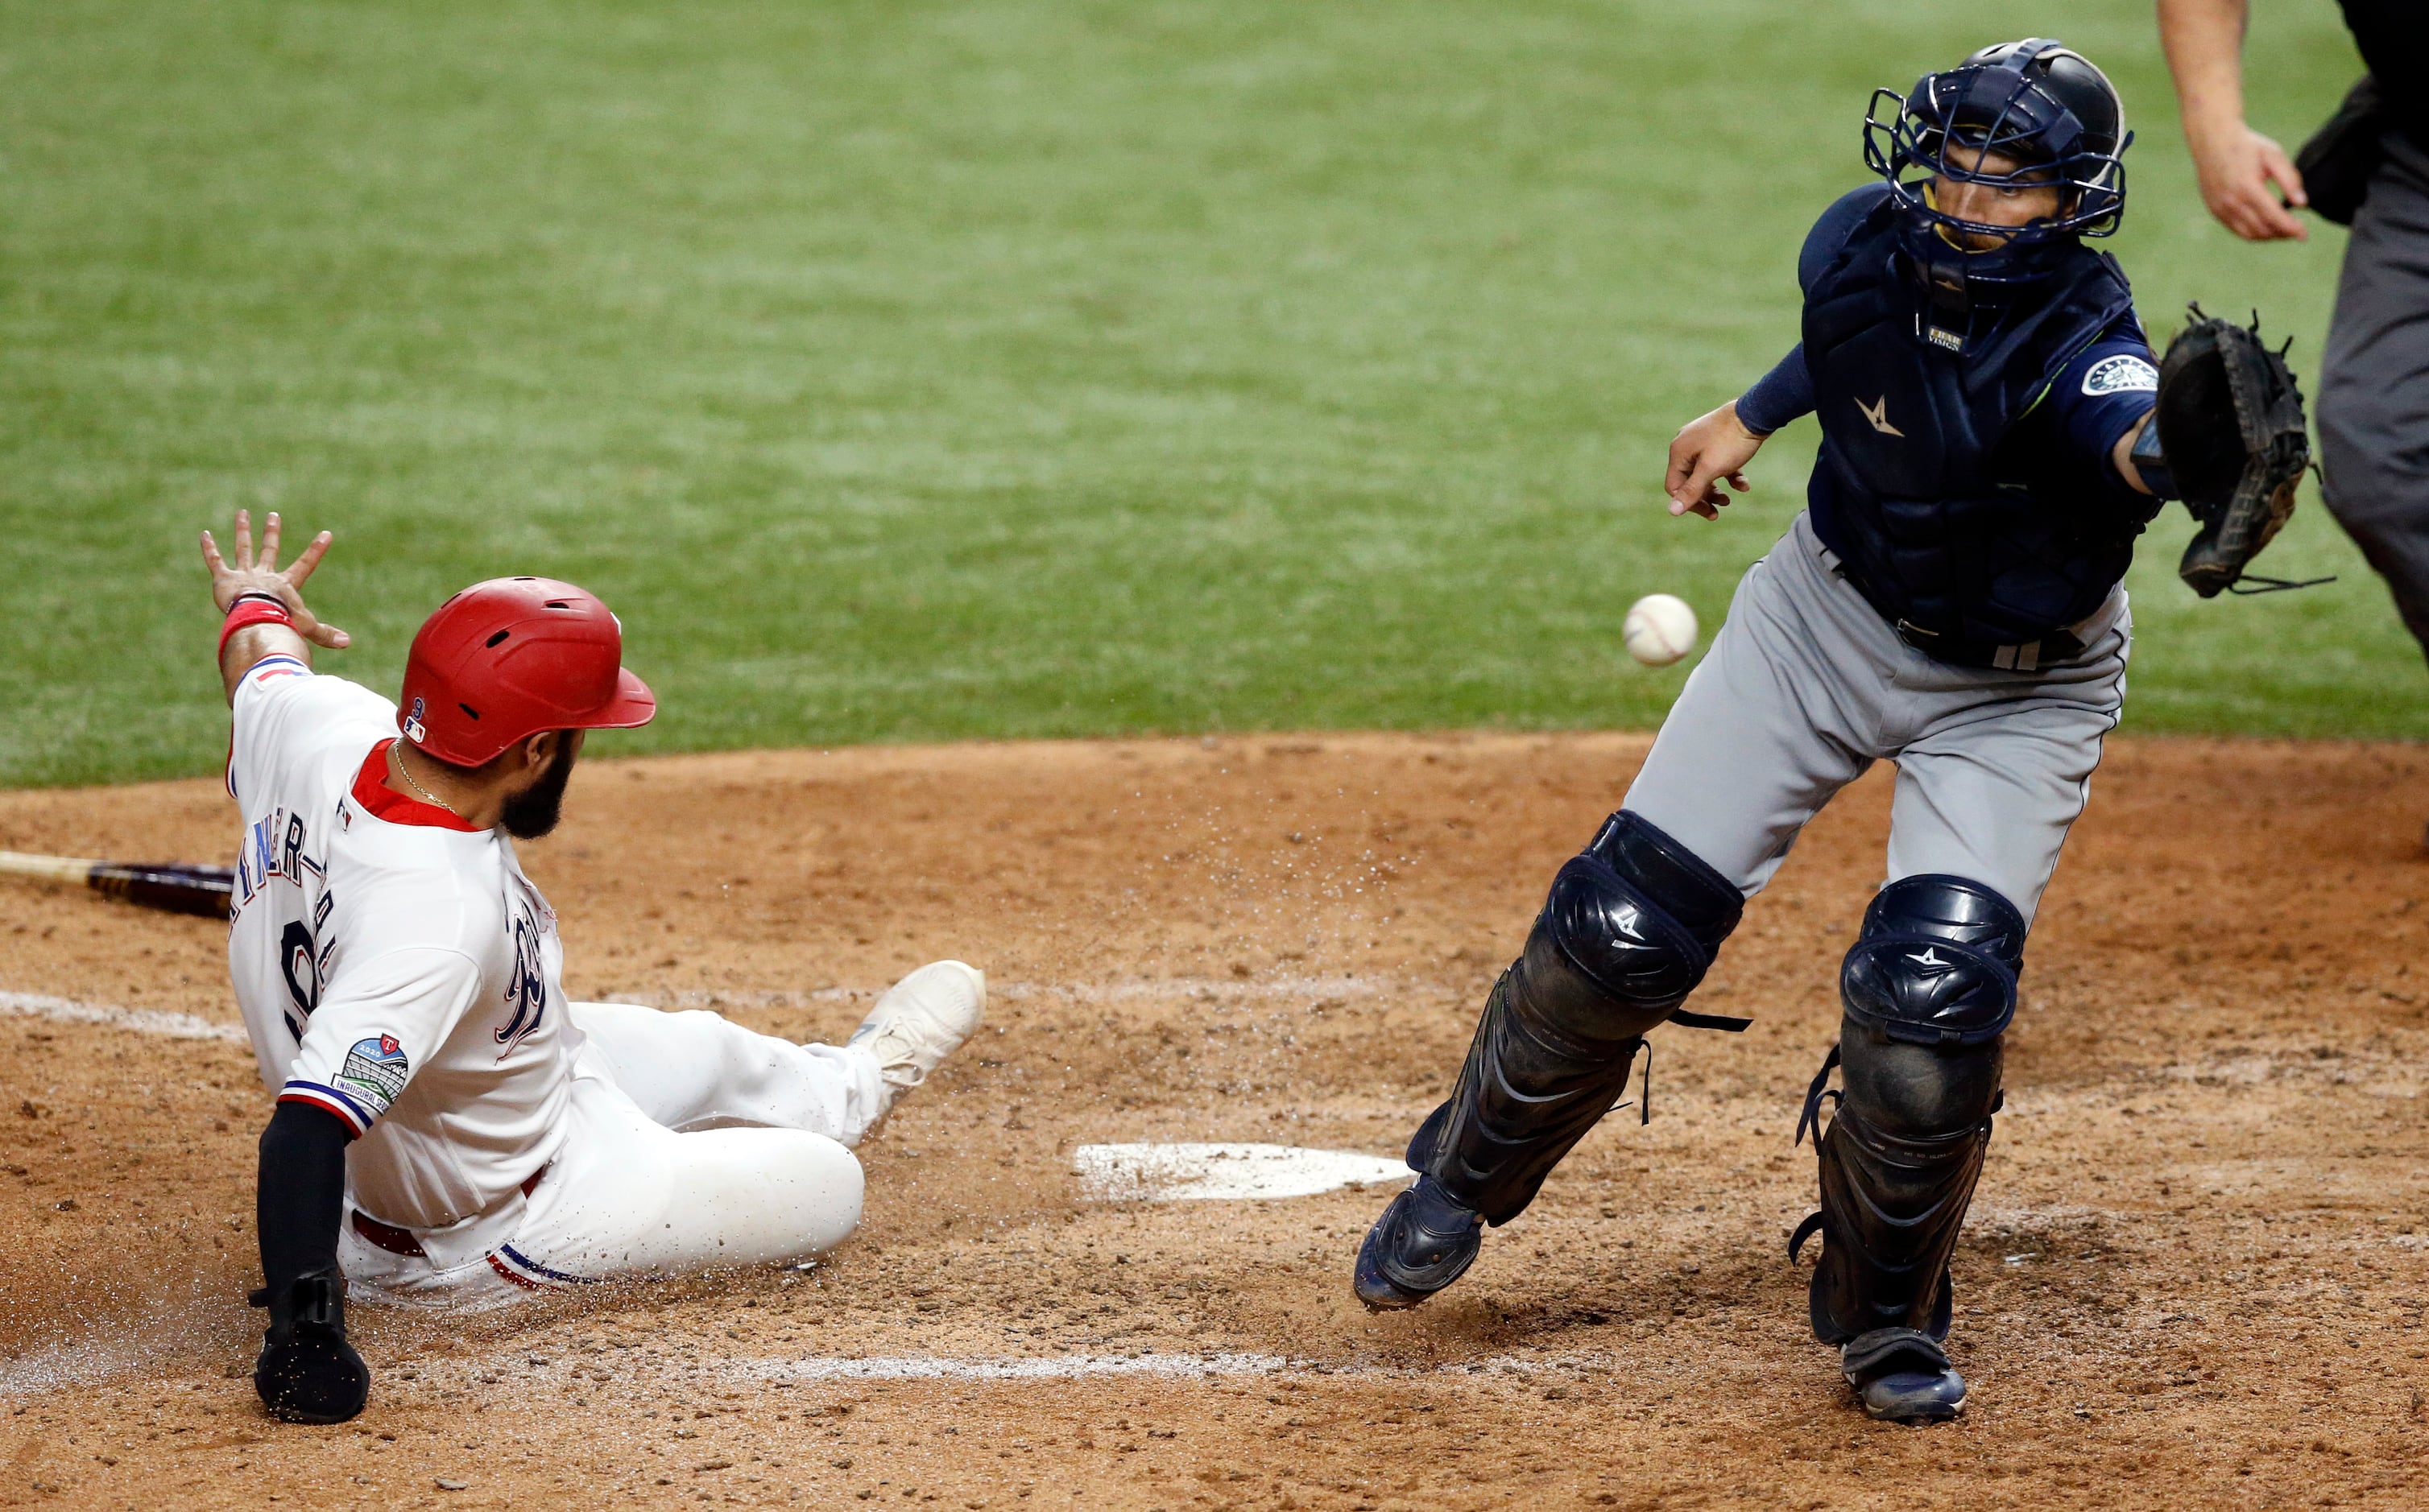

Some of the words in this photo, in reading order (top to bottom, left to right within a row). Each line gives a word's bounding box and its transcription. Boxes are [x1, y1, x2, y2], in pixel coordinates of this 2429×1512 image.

[412, 696, 424, 721] 9
[359, 1044, 381, 1057] 2020
[385, 1039, 395, 1051] T
[337, 1080, 376, 1105] INAUGURAL
